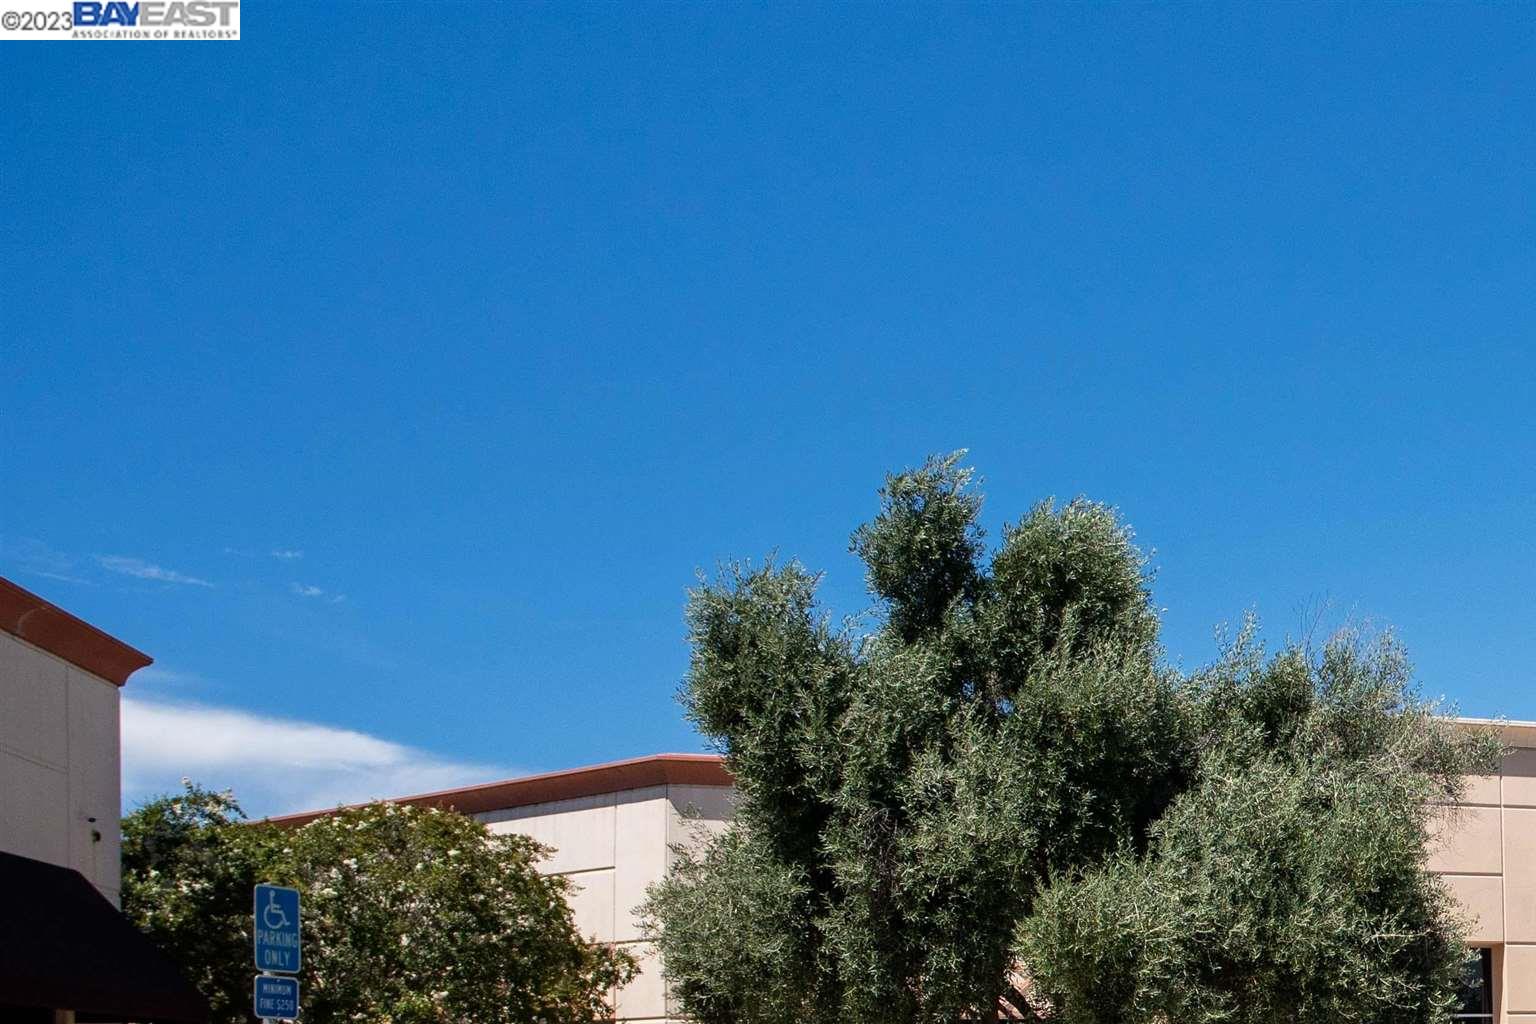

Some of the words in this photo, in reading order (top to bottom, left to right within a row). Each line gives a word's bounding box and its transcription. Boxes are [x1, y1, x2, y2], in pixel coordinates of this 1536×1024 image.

[258, 930, 297, 947] PARKING
[265, 950, 290, 967] ONLY
[263, 984, 291, 996] MINIMUM
[260, 998, 274, 1009] FINE
